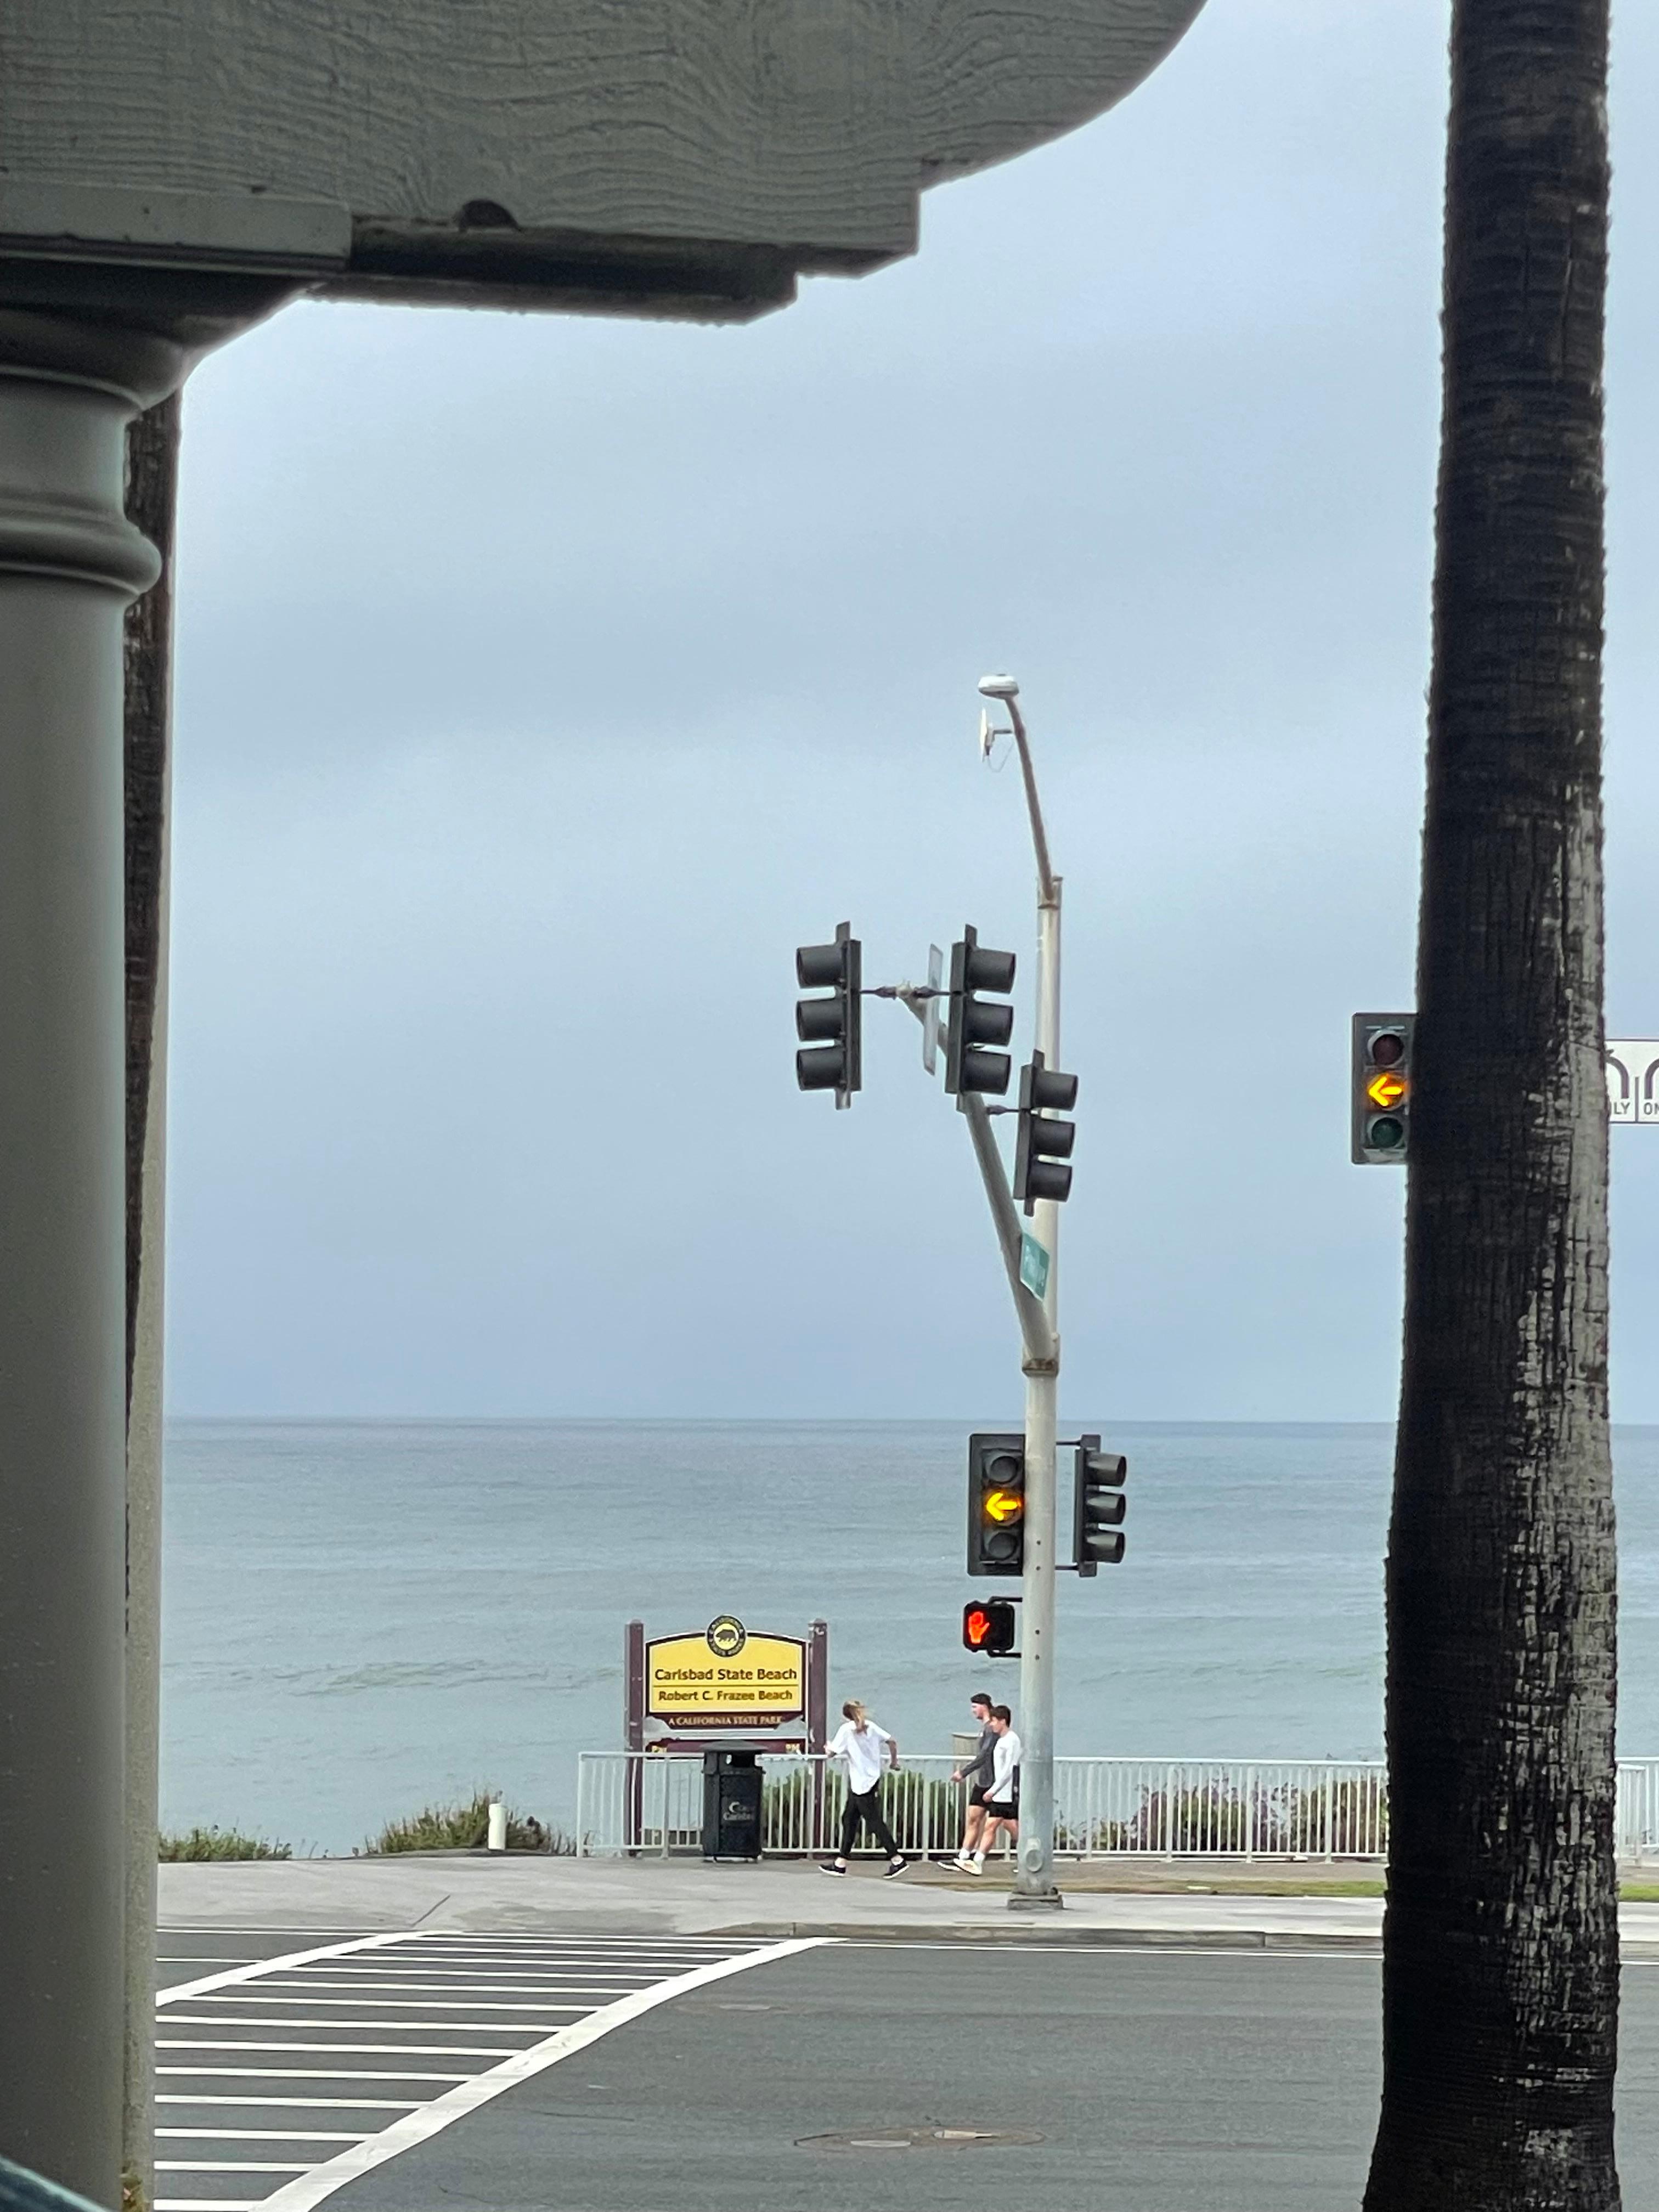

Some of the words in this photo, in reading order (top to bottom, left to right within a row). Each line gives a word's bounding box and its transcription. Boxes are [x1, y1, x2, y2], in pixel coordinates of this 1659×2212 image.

[655, 1669, 713, 1680] Carlsbad
[718, 1669, 753, 1680] State
[758, 1668, 797, 1680] Beach
[658, 1691, 698, 1701] Robert
[717, 1691, 754, 1701] Frazee
[759, 1690, 792, 1700] Beach
[676, 1717, 731, 1725] CALIFORNIA
[733, 1716, 757, 1725] STATE
[758, 1716, 782, 1725] PARK
